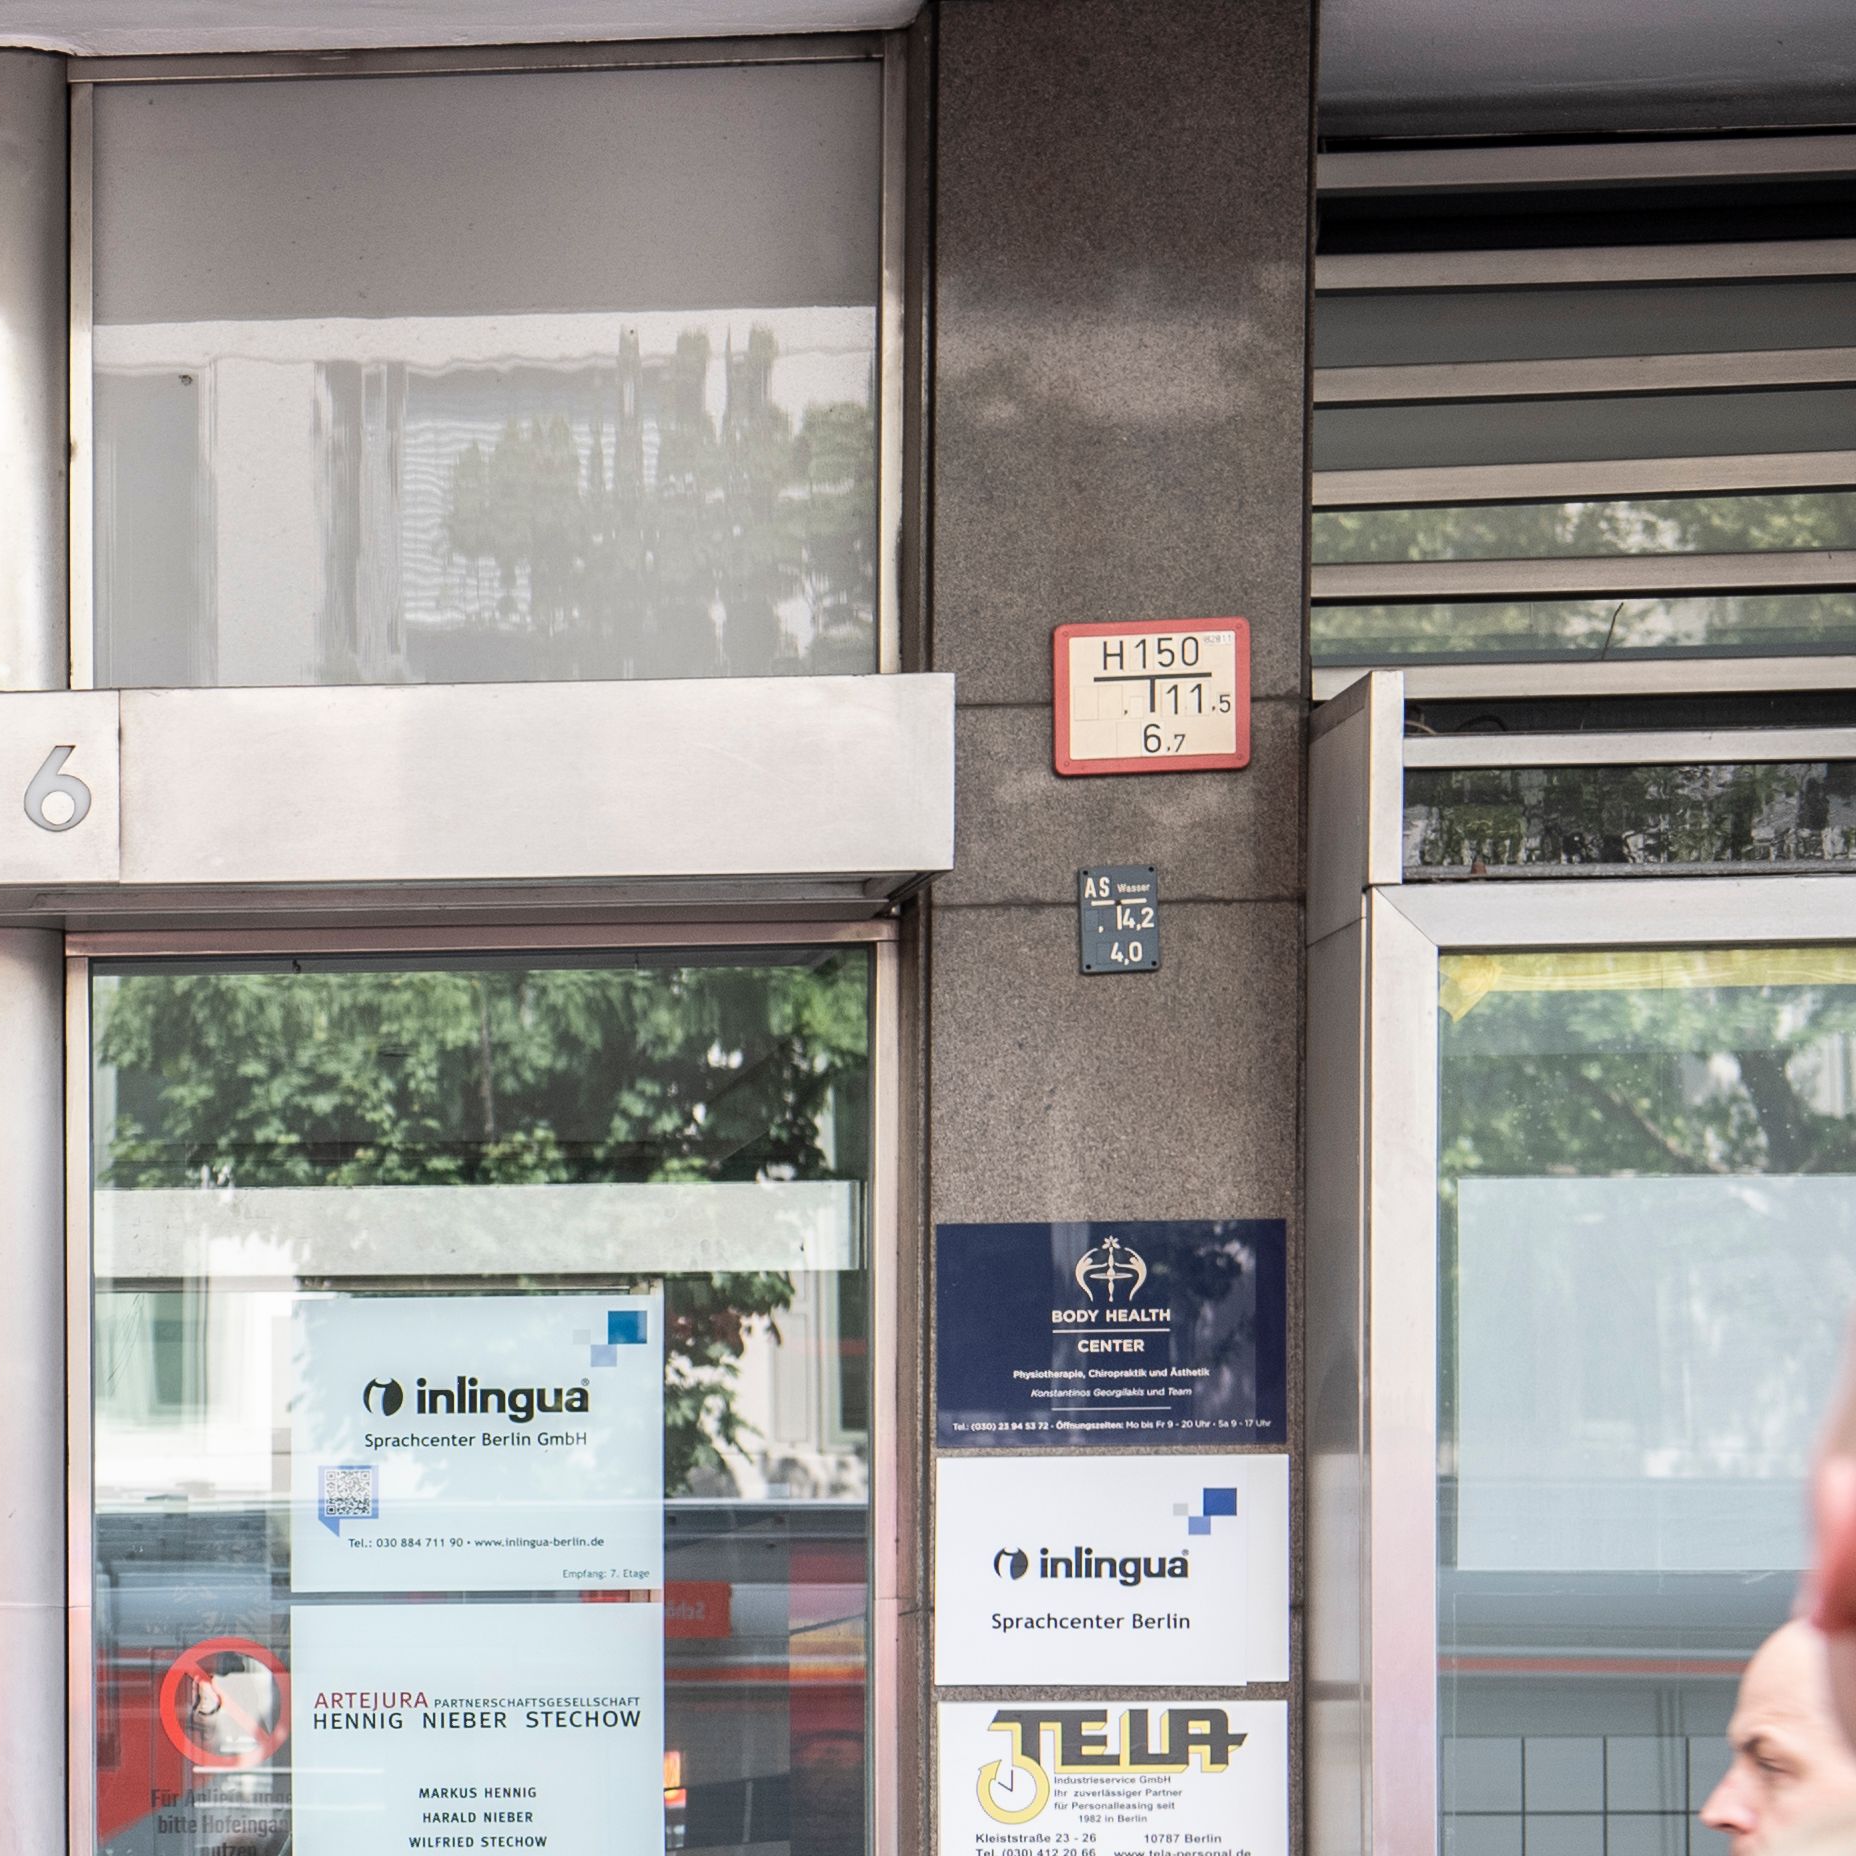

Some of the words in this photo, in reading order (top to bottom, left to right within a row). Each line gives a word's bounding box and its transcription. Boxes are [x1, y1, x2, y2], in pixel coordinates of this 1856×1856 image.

[1103, 636, 1199, 671] H150
[1084, 876, 1110, 898] AS
[1051, 1309, 1100, 1323] BODY
[1105, 1307, 1172, 1323] HEALTH
[1077, 1338, 1145, 1354] CENTER
[416, 1375, 589, 1424] inlingua
[364, 1433, 476, 1451] Sprachcenter
[481, 1432, 531, 1446] Berlin
[537, 1431, 588, 1446] GmbH
[376, 1538, 397, 1547] 030
[400, 1538, 421, 1547] 884
[426, 1538, 445, 1547] 711
[450, 1538, 464, 1547] 90
[474, 1537, 605, 1550] www.inlingua-berlin.de
[623, 1569, 650, 1579] Etage
[1040, 1546, 1189, 1587] inlingua
[992, 1613, 1125, 1633] Sprachcenter
[1132, 1613, 1191, 1630] Berlin
[314, 1691, 429, 1712] ARTEJURA
[434, 1696, 641, 1708] PARTNERSCHAFTSGESELLSCHAFT
[313, 1712, 404, 1729] HENNIG
[422, 1711, 507, 1729] NIEBER
[525, 1710, 641, 1728] STECHOW
[987, 1708, 1248, 1773] TELA
[418, 1787, 478, 1799] MARKUS
[484, 1787, 538, 1799] HENNIG
[422, 1811, 477, 1823] HARALD
[483, 1811, 534, 1824] NIEBER
[408, 1837, 474, 1848] WILFRIED
[481, 1836, 548, 1848] STECHOW
[975, 1833, 1051, 1844] Kleiststraße
[1055, 1833, 1070, 1844] 23
[1082, 1833, 1097, 1844] 26
[1144, 1834, 1180, 1844] 10787
[1184, 1834, 1222, 1844] Berlin
